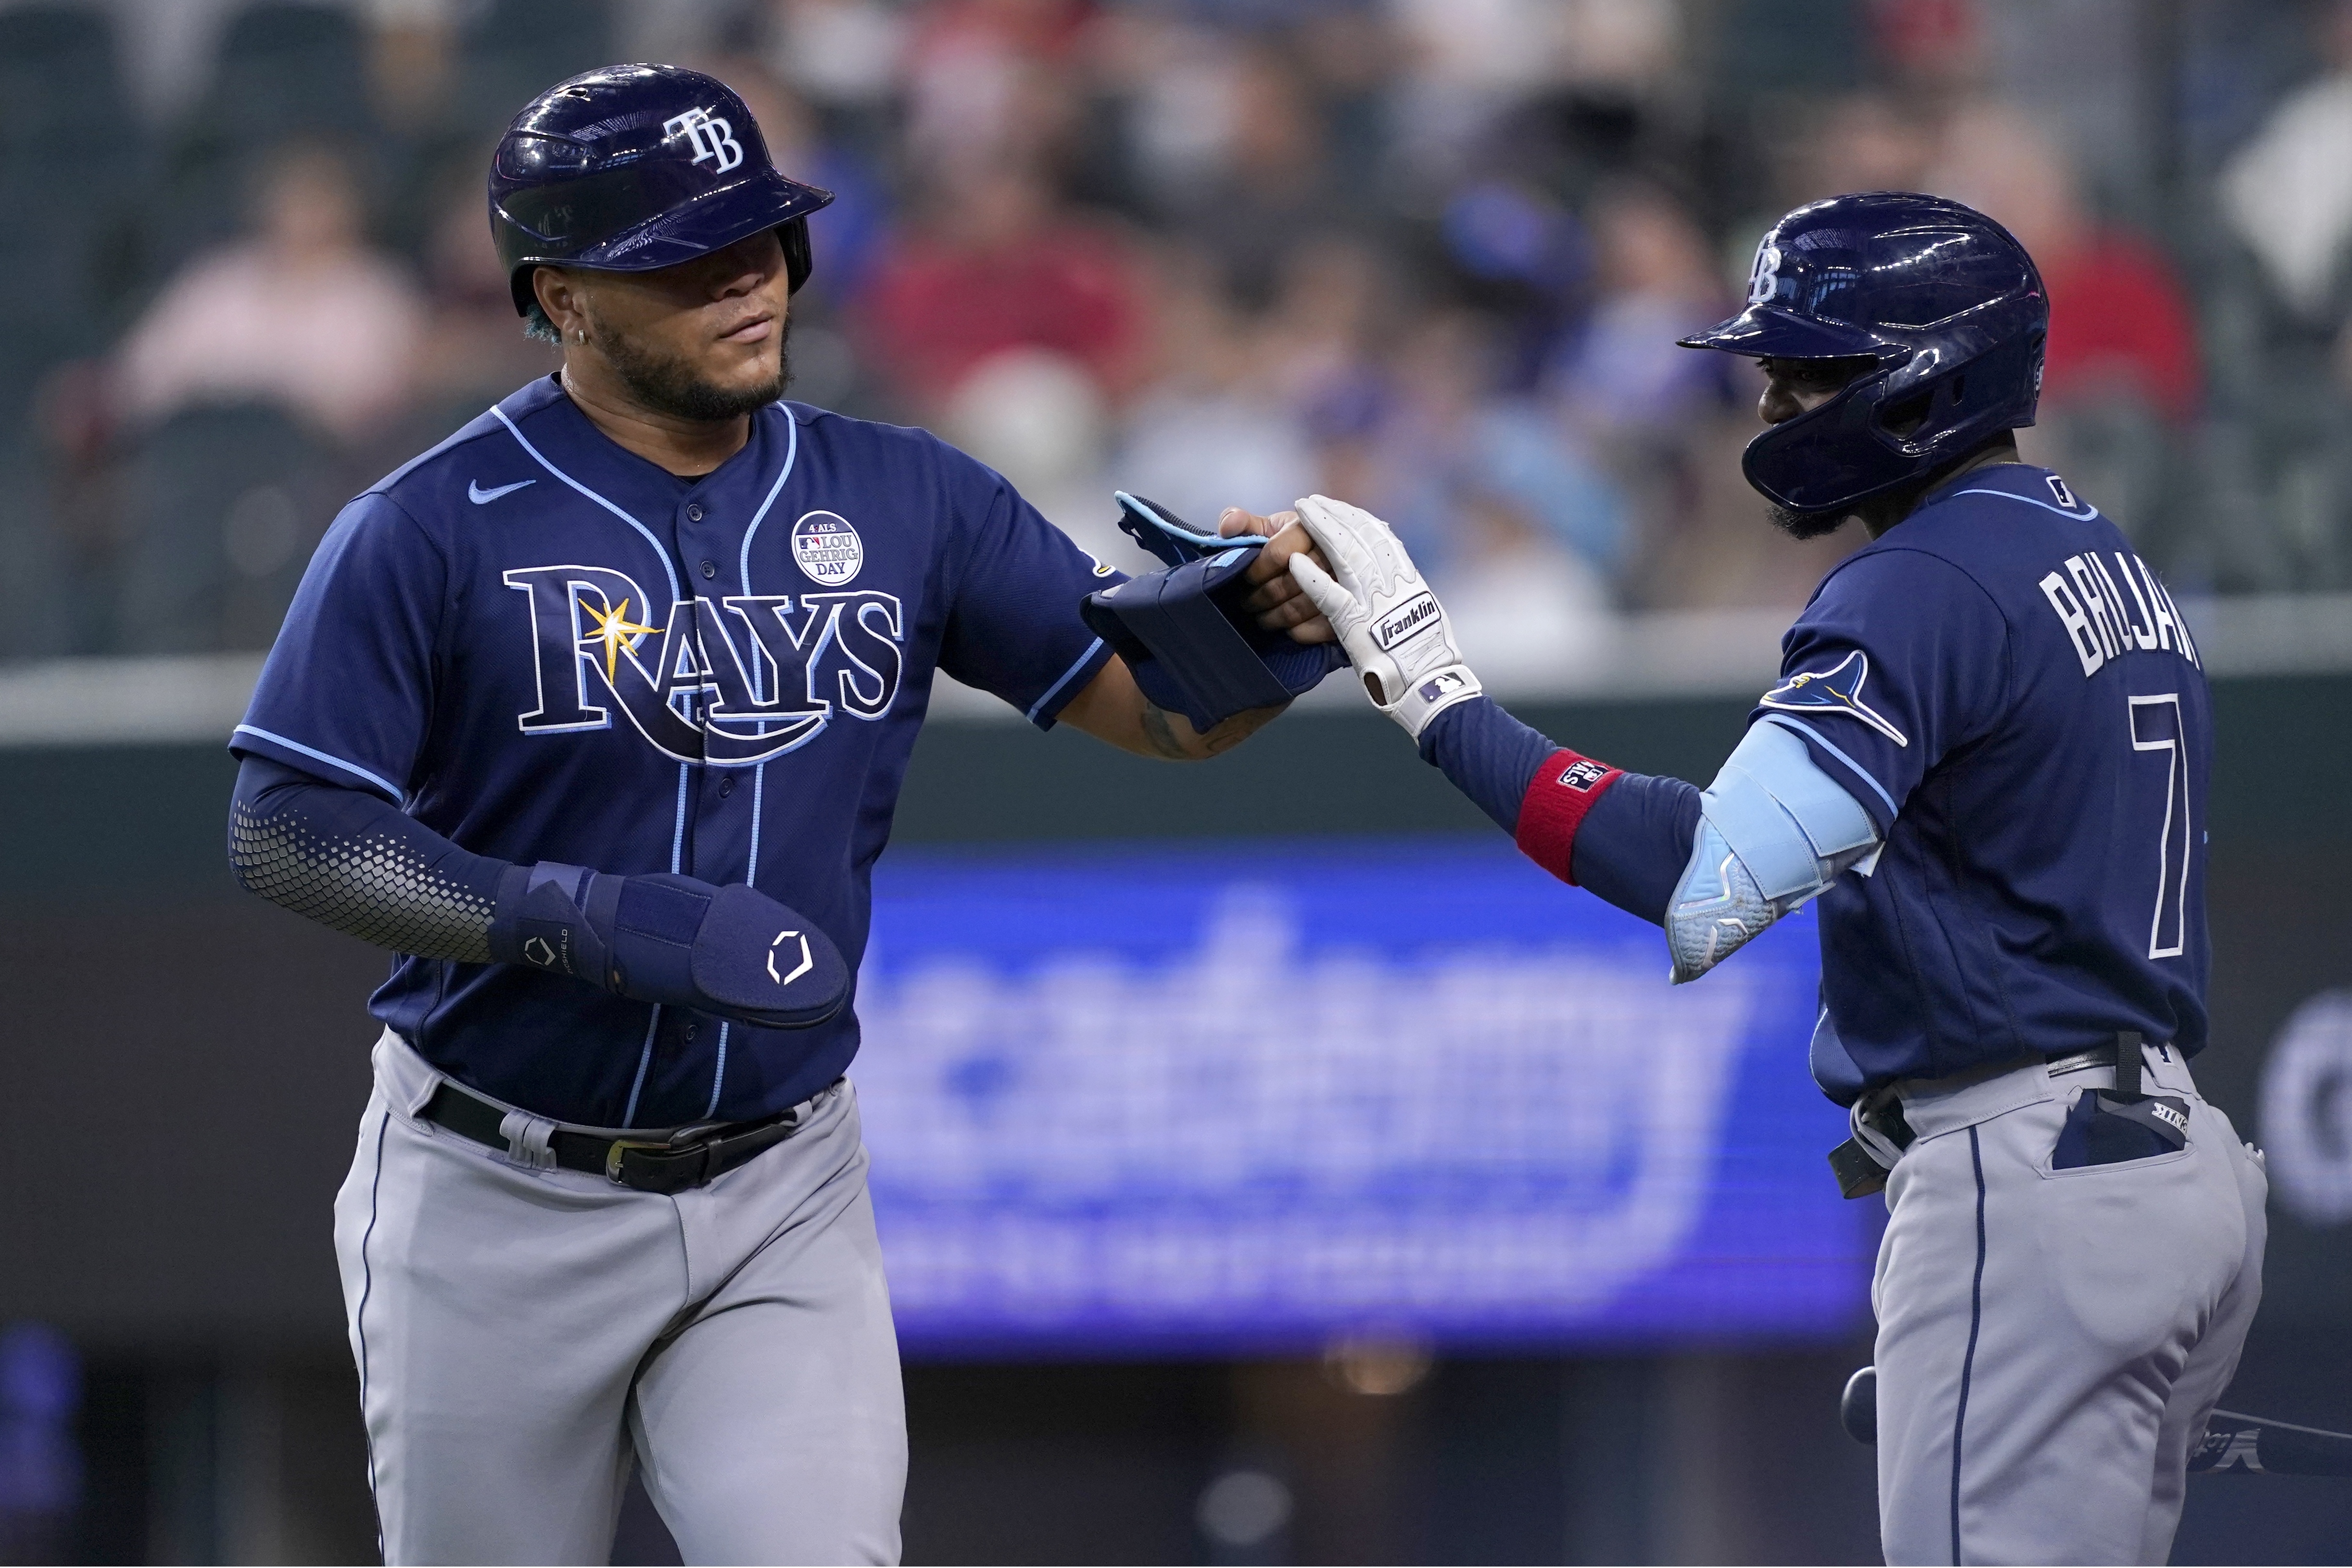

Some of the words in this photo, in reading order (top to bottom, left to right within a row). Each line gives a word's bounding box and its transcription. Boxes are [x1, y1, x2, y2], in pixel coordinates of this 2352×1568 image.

[662, 106, 744, 175] TB
[799, 548, 859, 563] GEHRIG
[821, 535, 852, 549] LOU
[815, 562, 846, 575] DAY
[1379, 599, 1436, 647] Franklin
[503, 564, 905, 767] RAYS
[2127, 693, 2190, 960] 7
